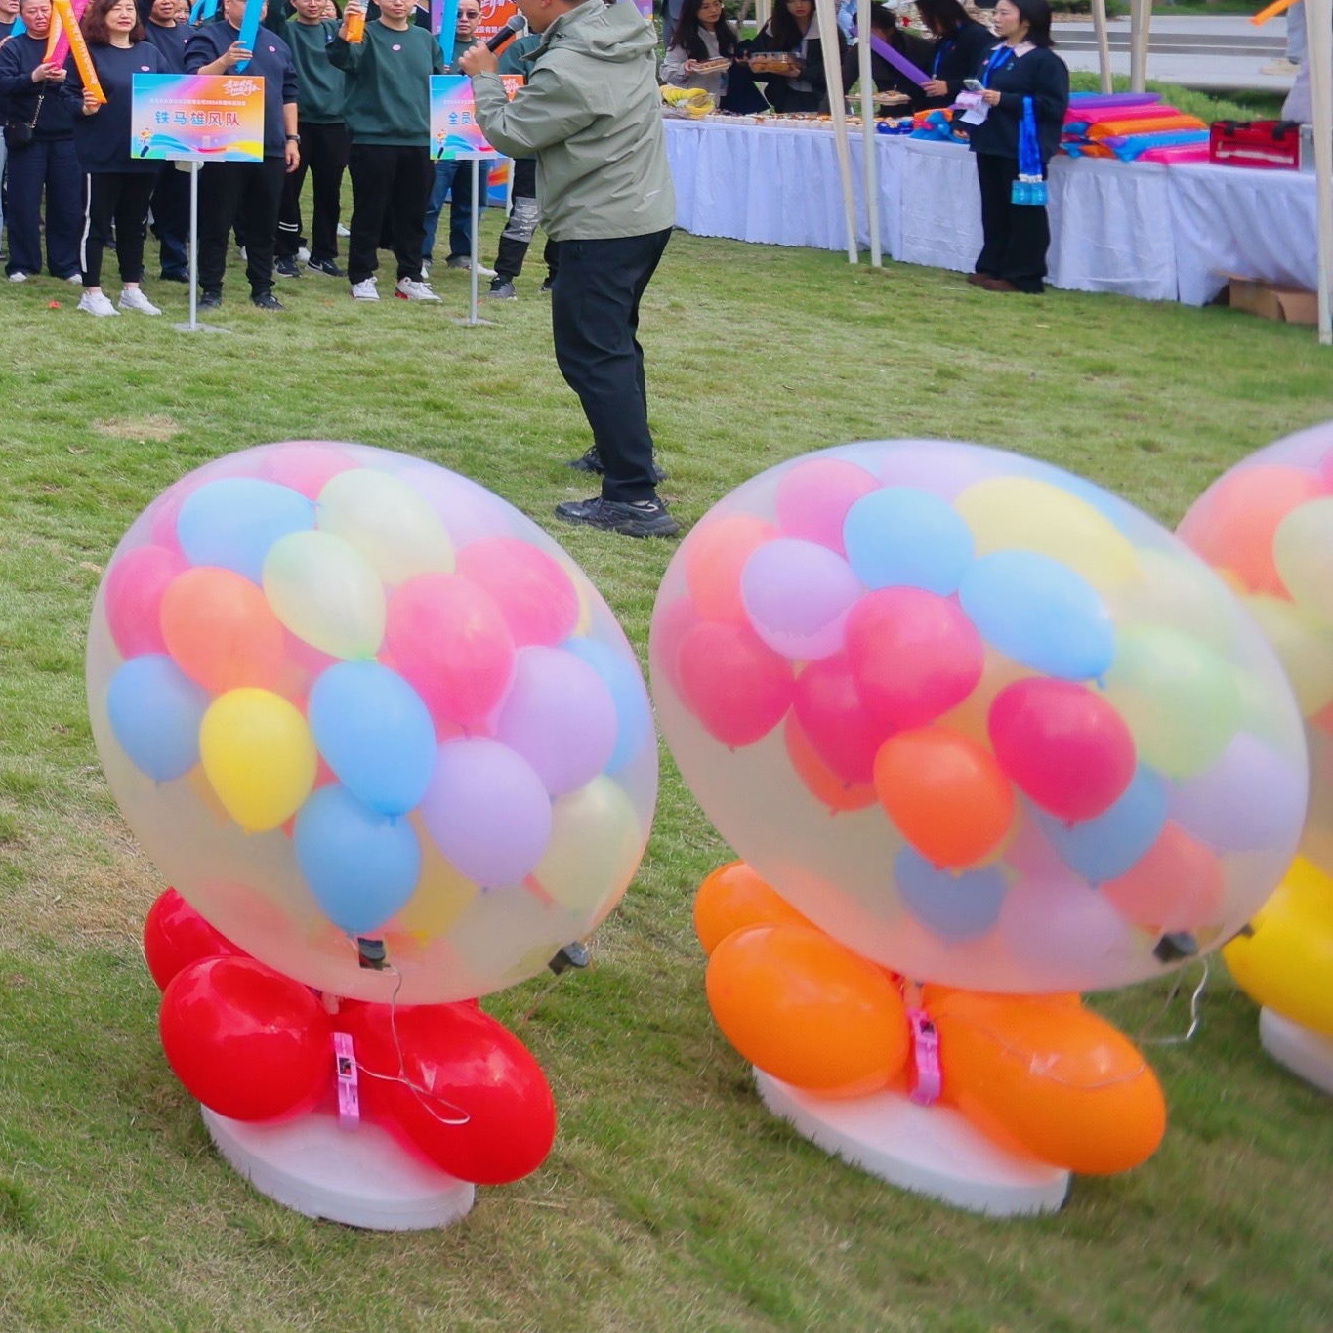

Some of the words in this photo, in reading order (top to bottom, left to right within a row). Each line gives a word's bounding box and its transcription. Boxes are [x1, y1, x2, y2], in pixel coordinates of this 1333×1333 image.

[155, 111, 240, 126] 铁马雄风队
[448, 111, 477, 125] 全员
